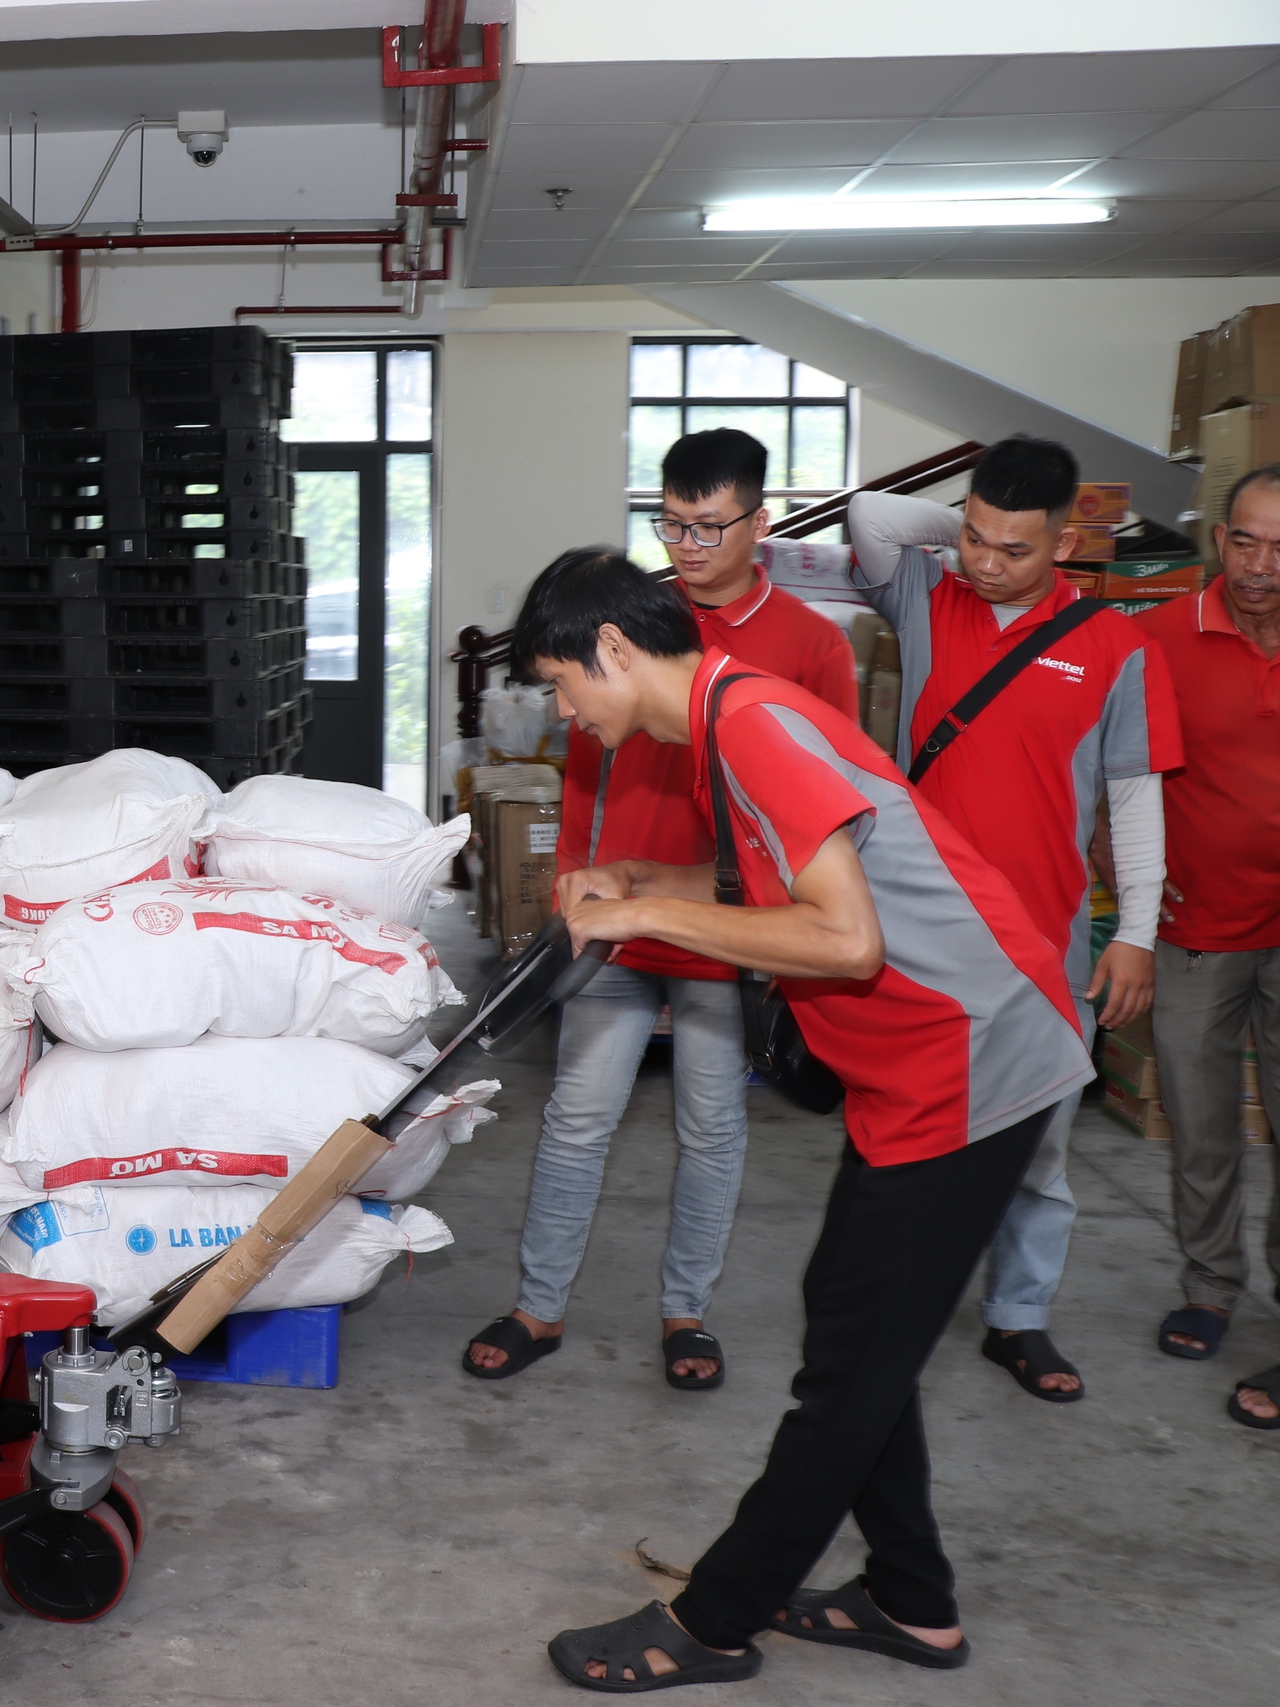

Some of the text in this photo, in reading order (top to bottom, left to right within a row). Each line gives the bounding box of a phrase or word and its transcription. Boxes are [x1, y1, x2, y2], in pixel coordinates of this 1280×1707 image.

[1037, 656, 1085, 676] viettel
[263, 921, 300, 938] SA
[175, 1151, 219, 1169] SA
[169, 1224, 241, 1247] LA BÀN
